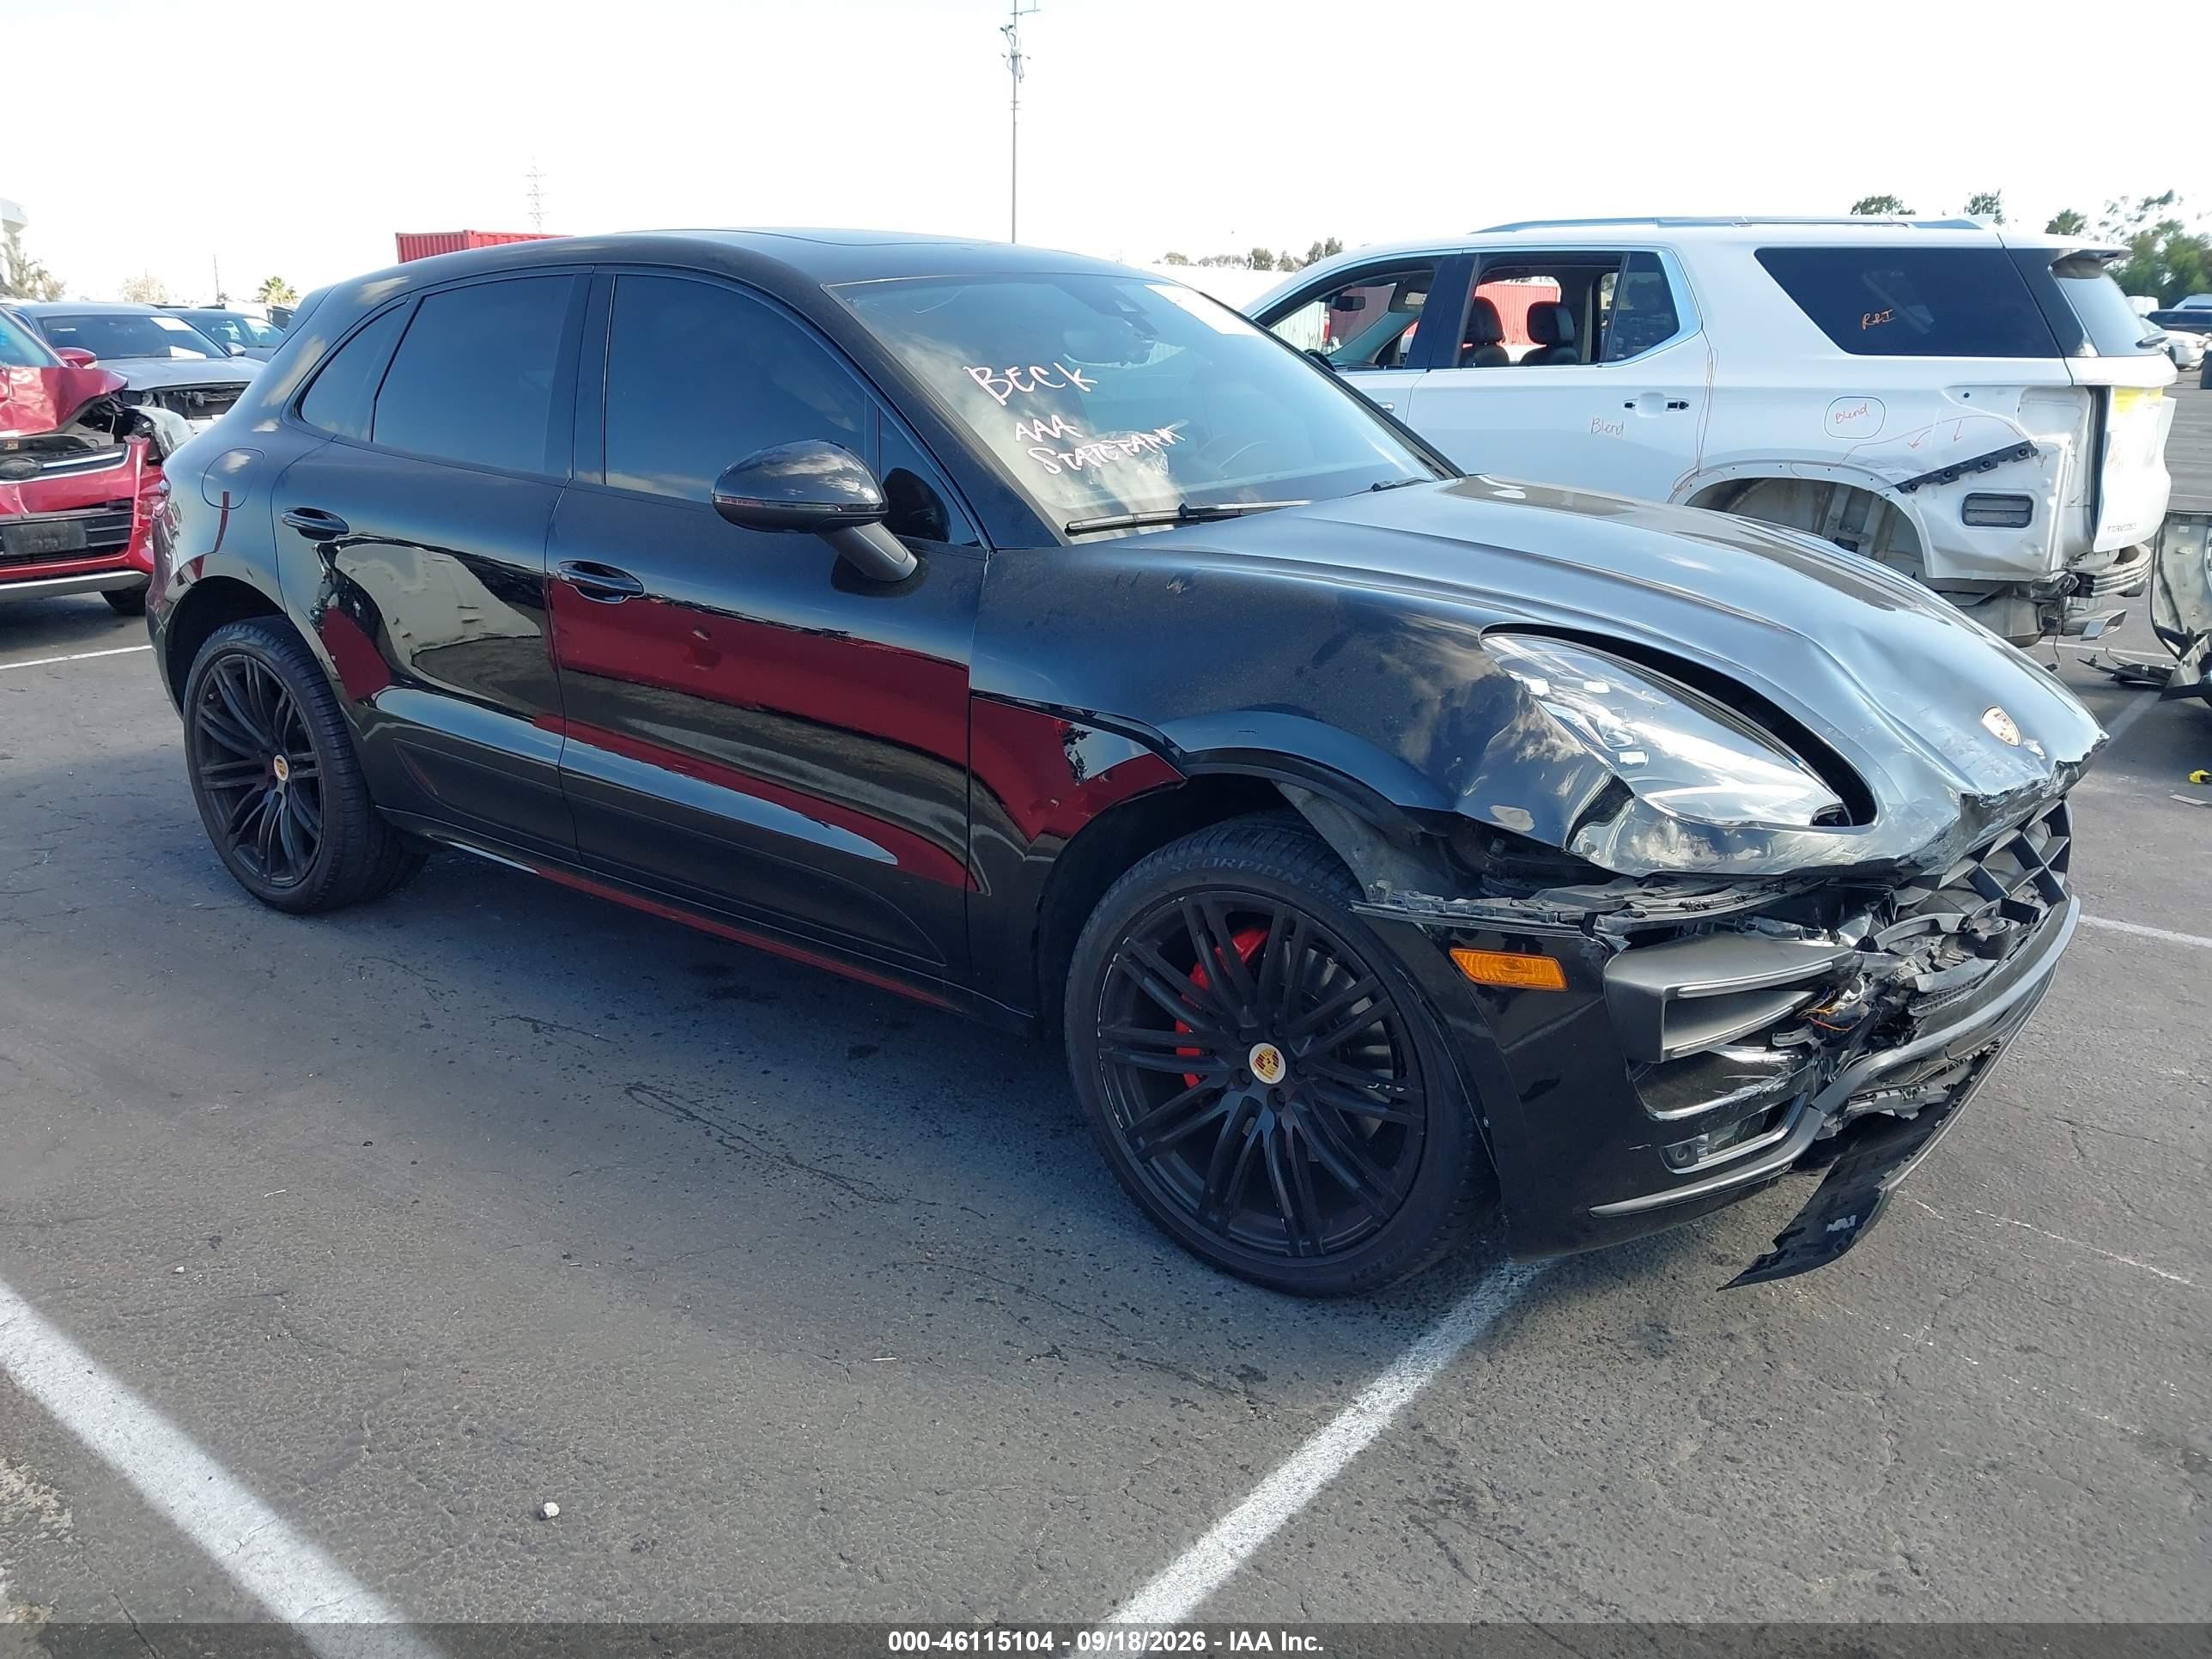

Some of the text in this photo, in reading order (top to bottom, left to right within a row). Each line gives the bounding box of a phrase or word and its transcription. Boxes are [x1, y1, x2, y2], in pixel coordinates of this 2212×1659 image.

[962, 362, 1098, 405] BECK
[1835, 402, 1869, 424] Blend
[1015, 414, 1084, 441] AAA
[1590, 417, 1624, 435] Blend
